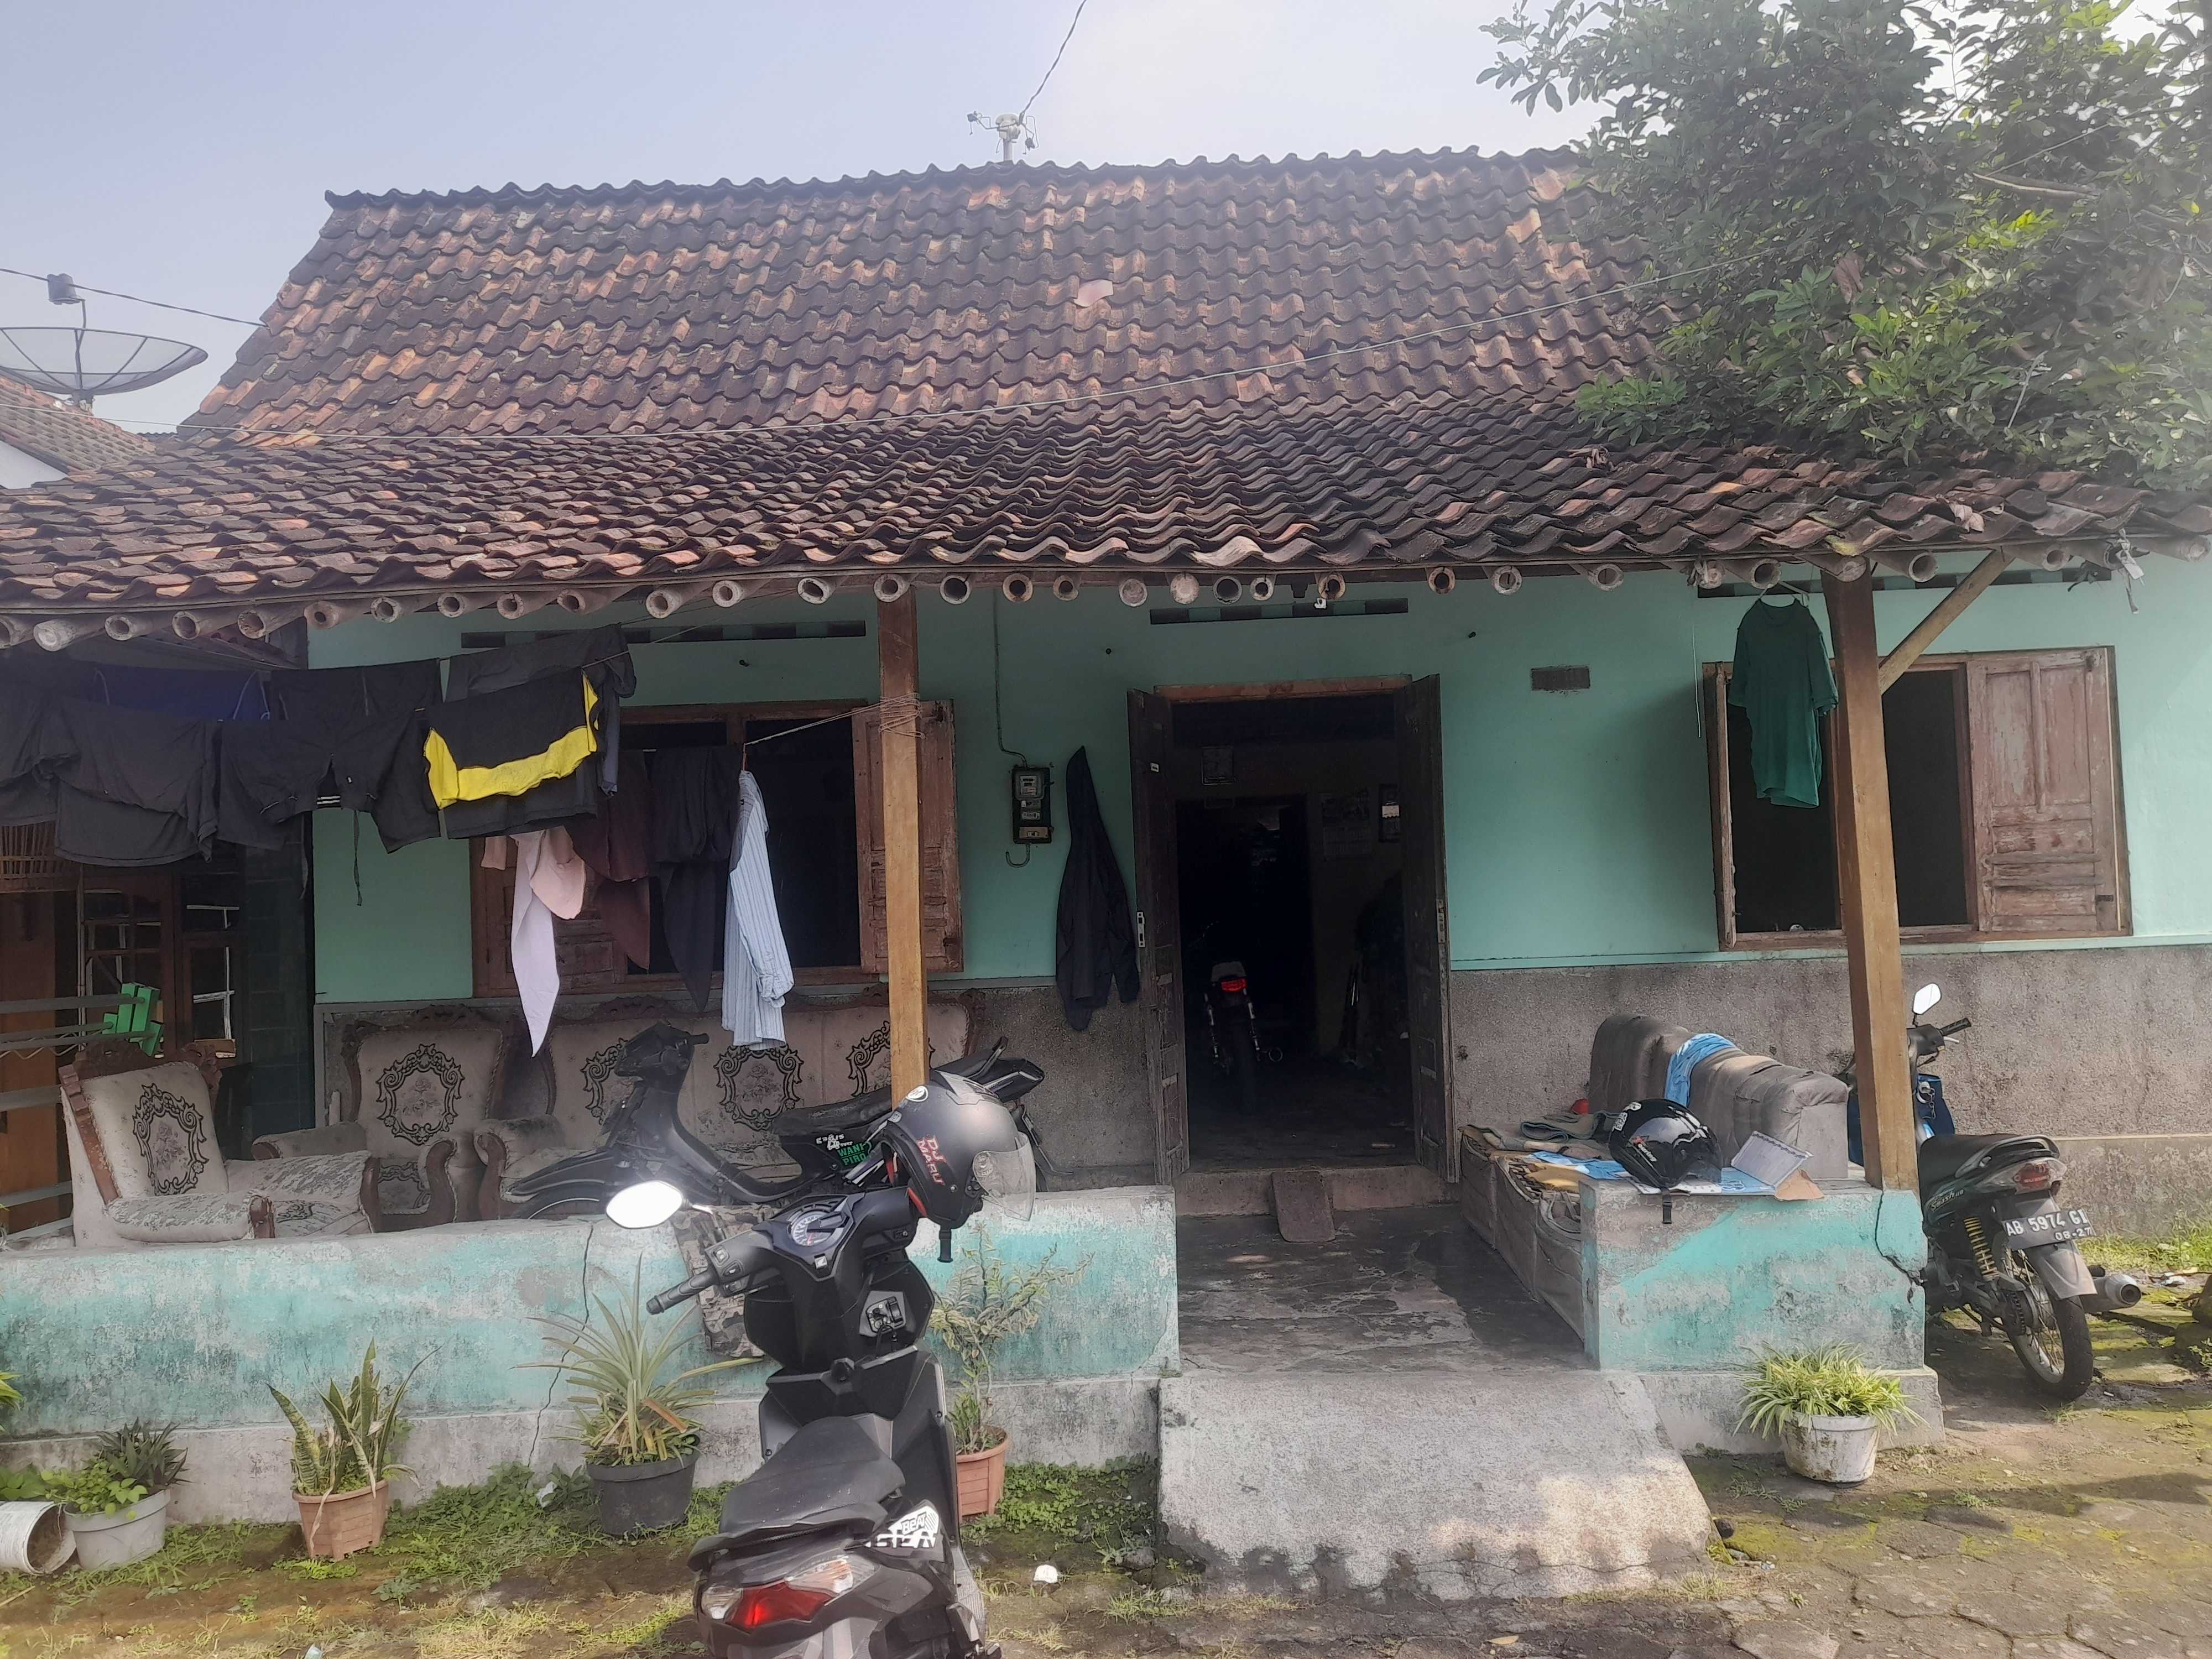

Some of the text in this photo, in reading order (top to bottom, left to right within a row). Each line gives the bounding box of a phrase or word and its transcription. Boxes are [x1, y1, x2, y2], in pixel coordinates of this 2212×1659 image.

[837, 1142, 864, 1156] WANI
[2006, 1220, 2024, 1237] AB
[2027, 1213, 2065, 1232] 5974
[2055, 1227, 2091, 1240] 08-27
[901, 1512, 927, 1535] BEAT
